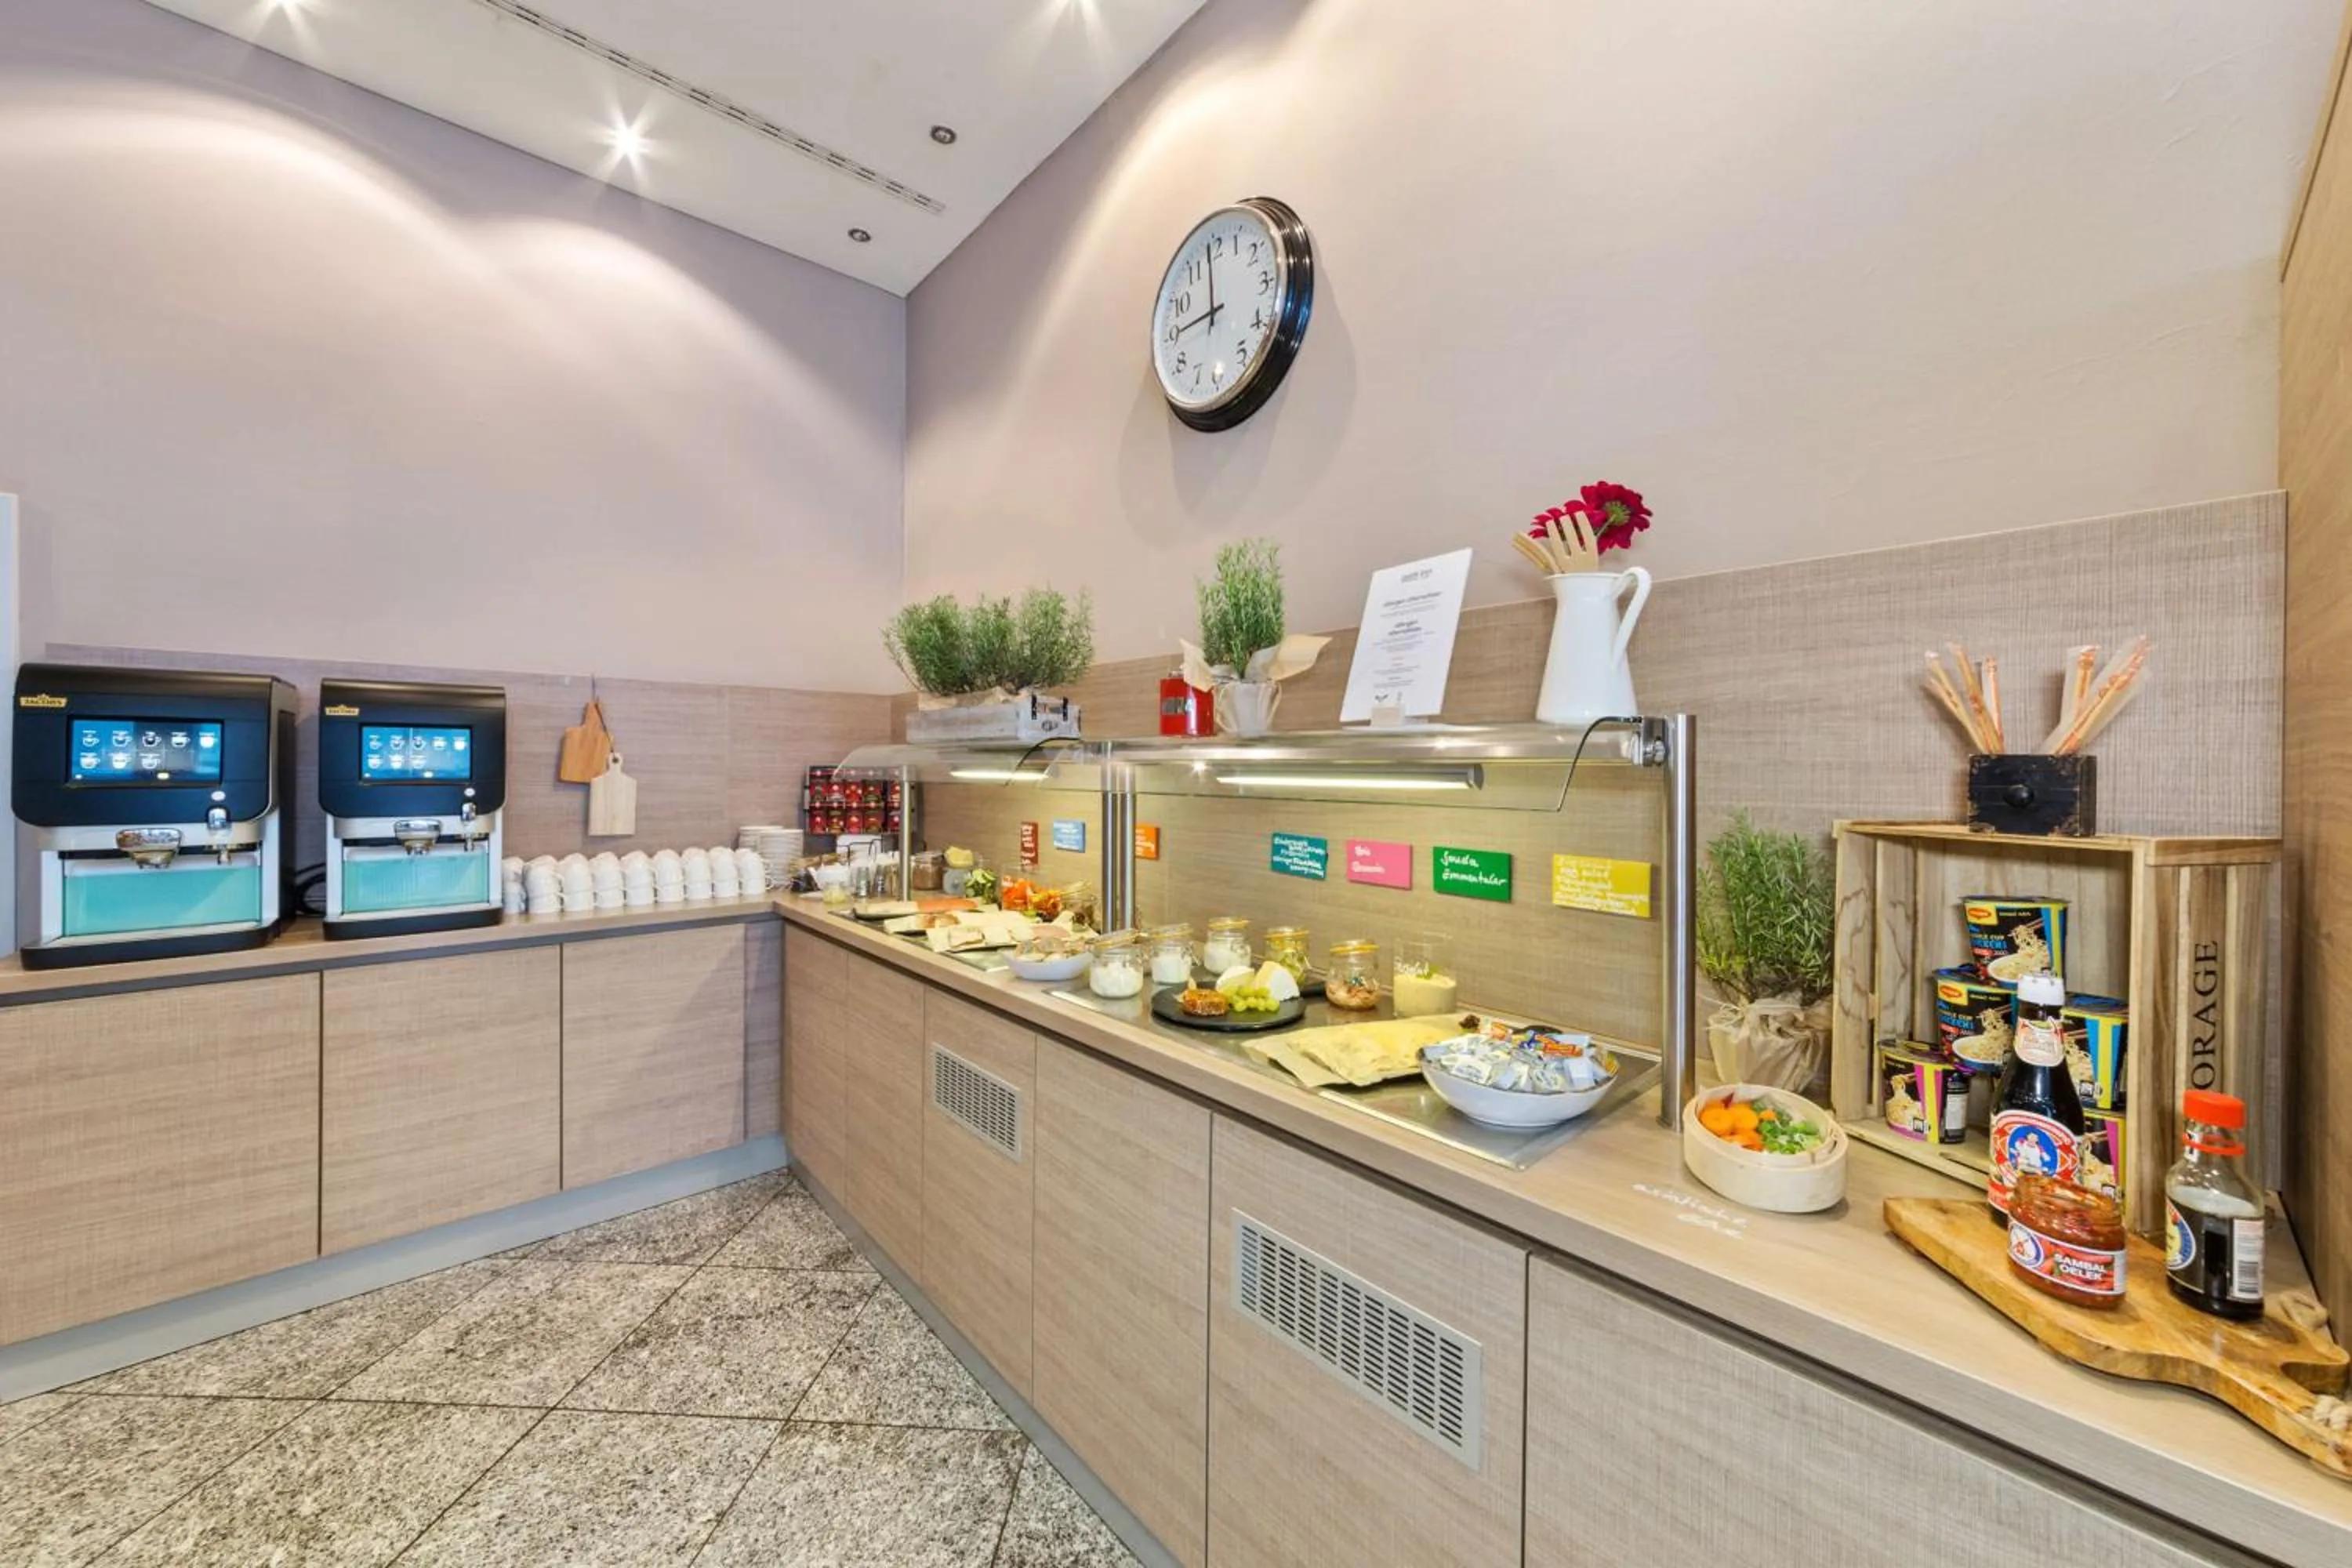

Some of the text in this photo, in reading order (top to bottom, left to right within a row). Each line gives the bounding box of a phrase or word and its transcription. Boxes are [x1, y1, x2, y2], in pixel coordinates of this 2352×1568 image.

[1247, 241, 1258, 267] 2
[1189, 260, 1201, 285] 11
[1258, 270, 1269, 296] 3
[1174, 291, 1191, 318] 10
[1250, 306, 1263, 330] 4
[1169, 325, 1179, 346] 9
[1176, 350, 1186, 374] 8
[1193, 362, 1203, 385] 7
[2191, 941, 2218, 1090] ORAGE
[2054, 1253, 2107, 1274] SAMBAL
